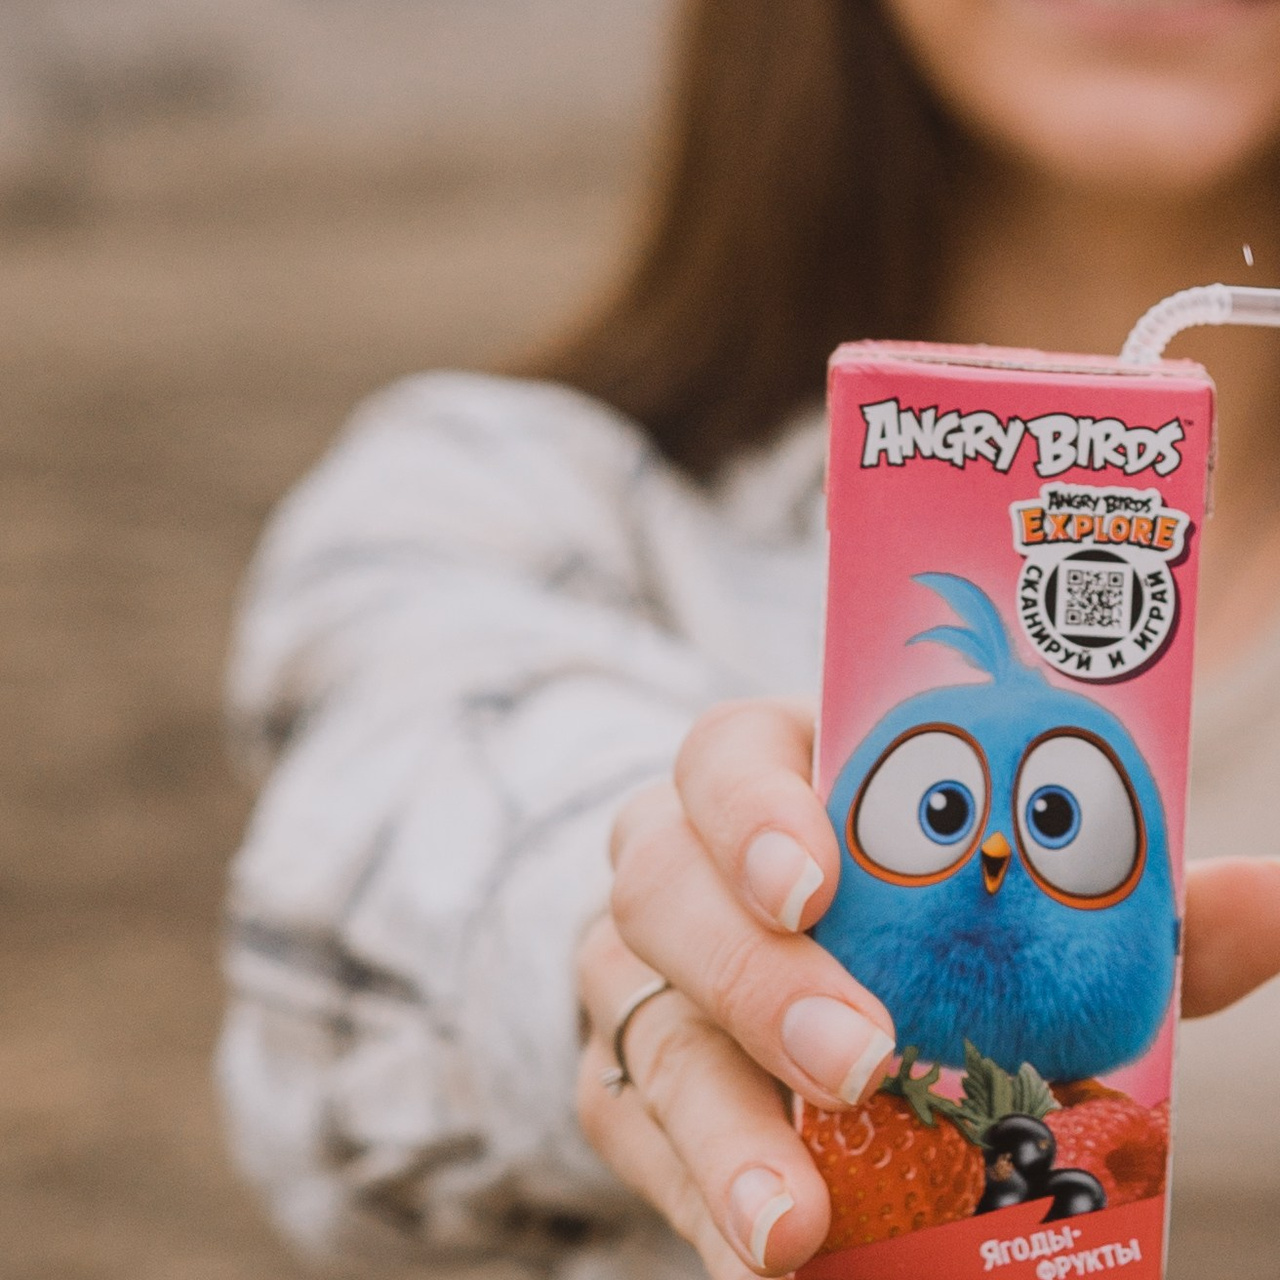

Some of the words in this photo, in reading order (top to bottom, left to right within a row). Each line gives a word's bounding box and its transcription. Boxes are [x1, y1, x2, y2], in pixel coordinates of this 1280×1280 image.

[860, 398, 1026, 474] ANGRY
[1025, 412, 1185, 477] BIRDS
[1019, 508, 1179, 551] EXPLORE
[1048, 491, 1099, 511] ANGRY
[1103, 494, 1152, 513] BIRDS
[1021, 565, 1092, 671] СКАНИРУЙ
[1108, 651, 1125, 669] И
[1133, 570, 1168, 651] ИГРАЙ
